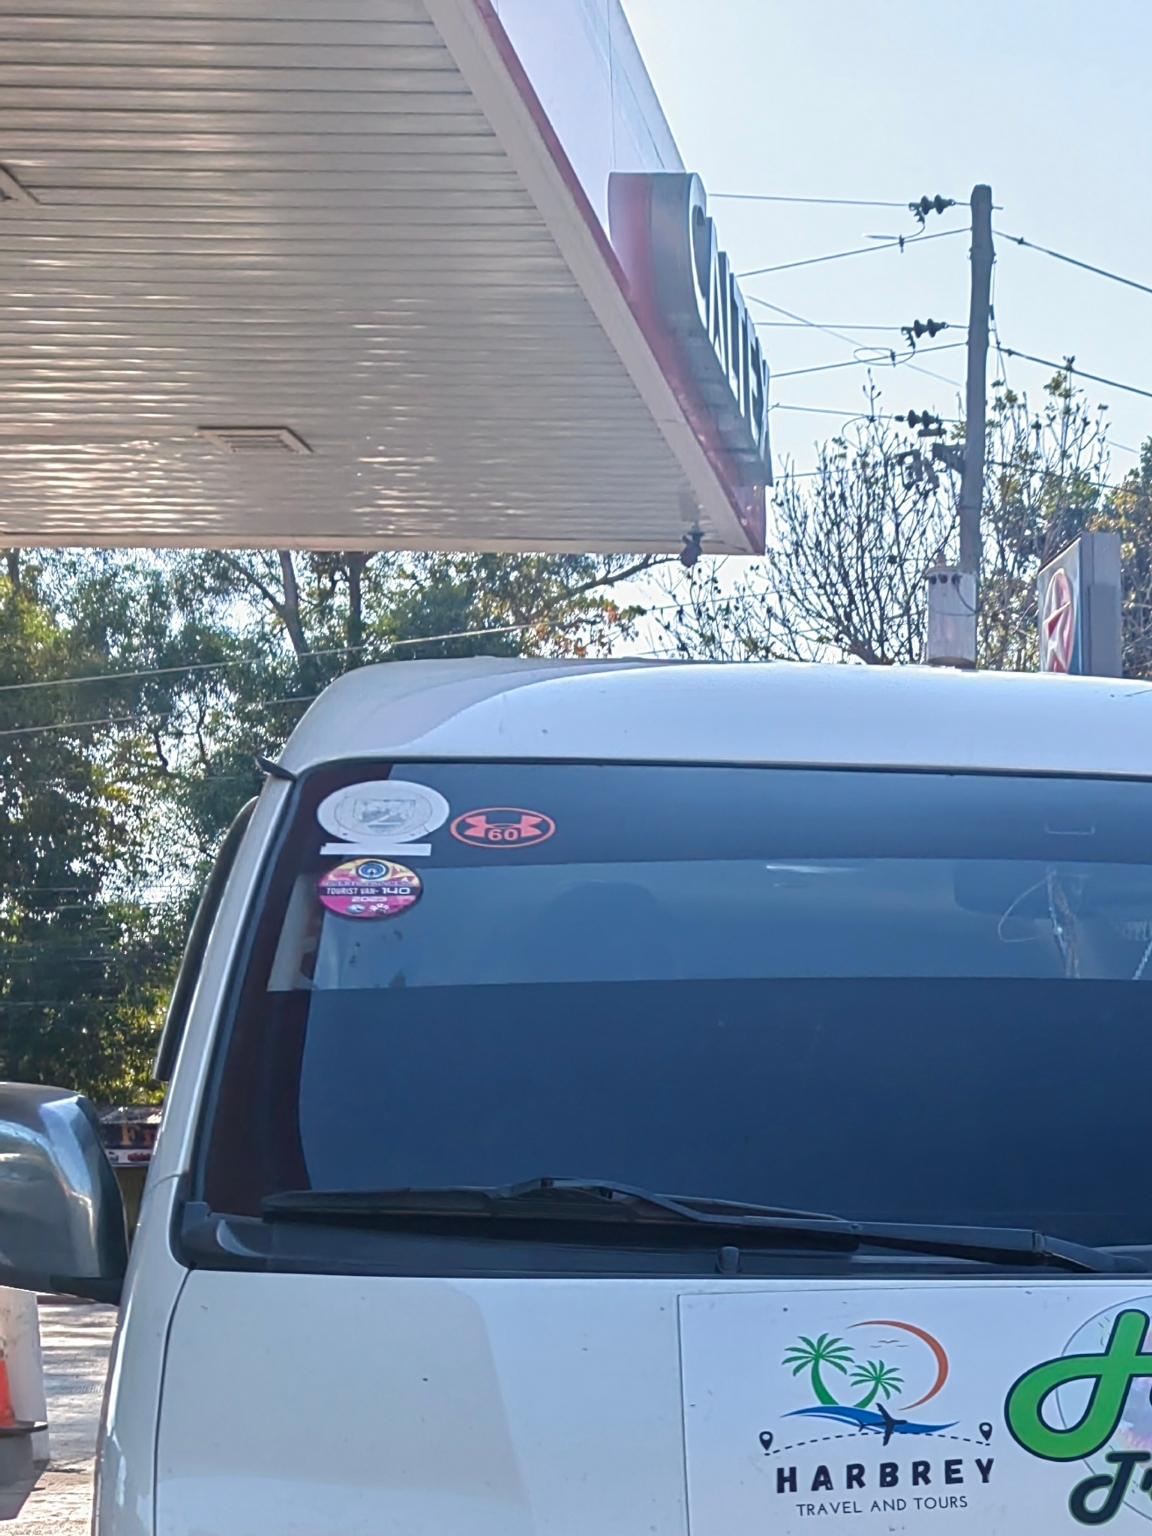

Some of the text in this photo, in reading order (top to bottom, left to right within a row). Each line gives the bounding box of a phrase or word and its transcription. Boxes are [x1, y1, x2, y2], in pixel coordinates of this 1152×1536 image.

[488, 827, 520, 841] 60
[326, 886, 358, 895] TOURIST
[381, 886, 412, 895] 140
[776, 1457, 996, 1494] HARBREY
[796, 1495, 969, 1517] TRAVEL AND TOURS
